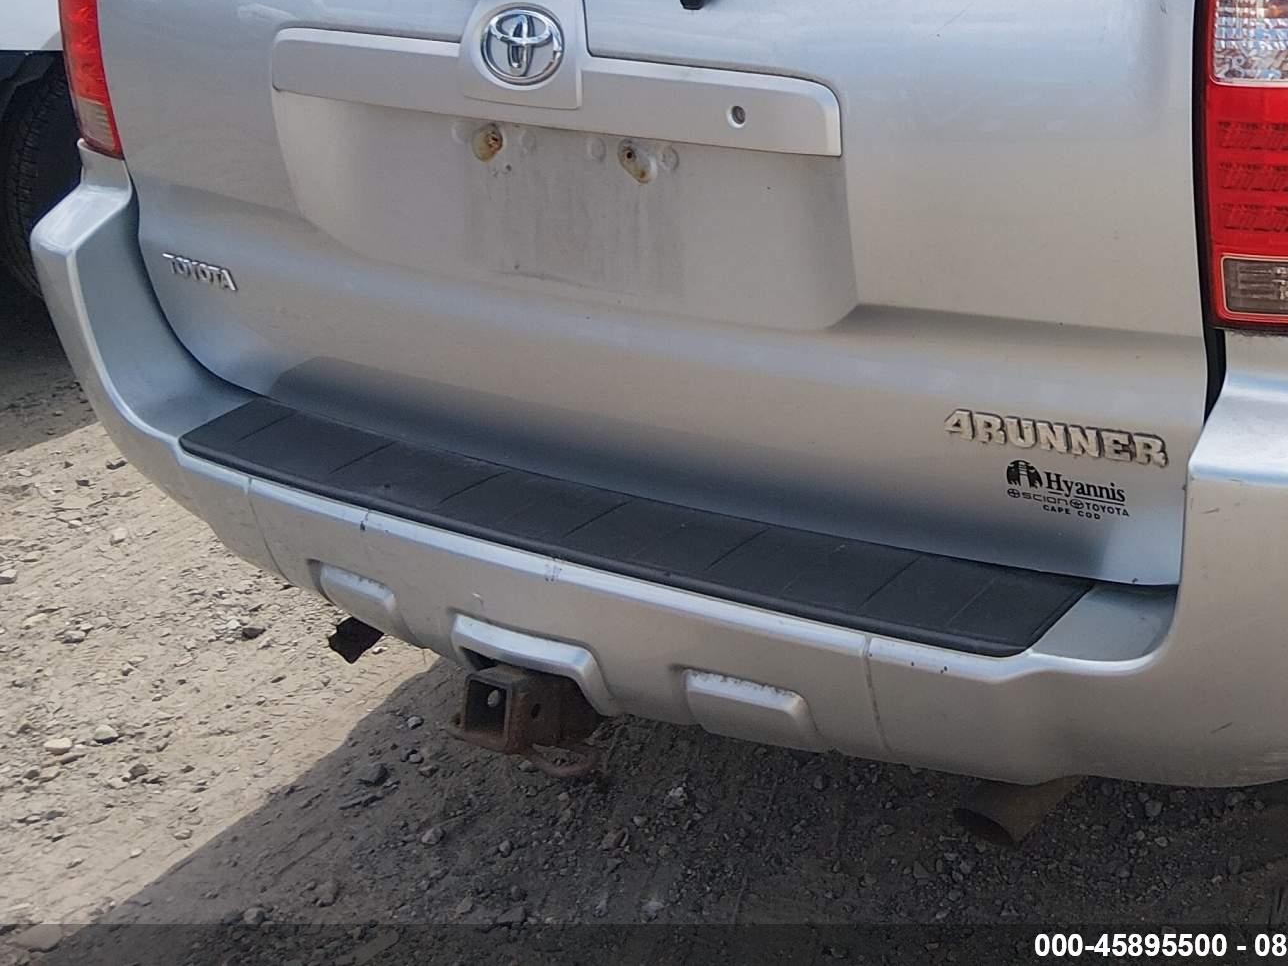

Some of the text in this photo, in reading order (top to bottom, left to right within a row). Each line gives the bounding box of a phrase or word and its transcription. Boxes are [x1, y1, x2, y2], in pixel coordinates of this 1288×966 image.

[944, 408, 1169, 468] 4RUNNER
[1044, 471, 1126, 502] Hyannis
[1043, 504, 1101, 520] CAPE COD
[1086, 502, 1130, 517] TOYOTA
